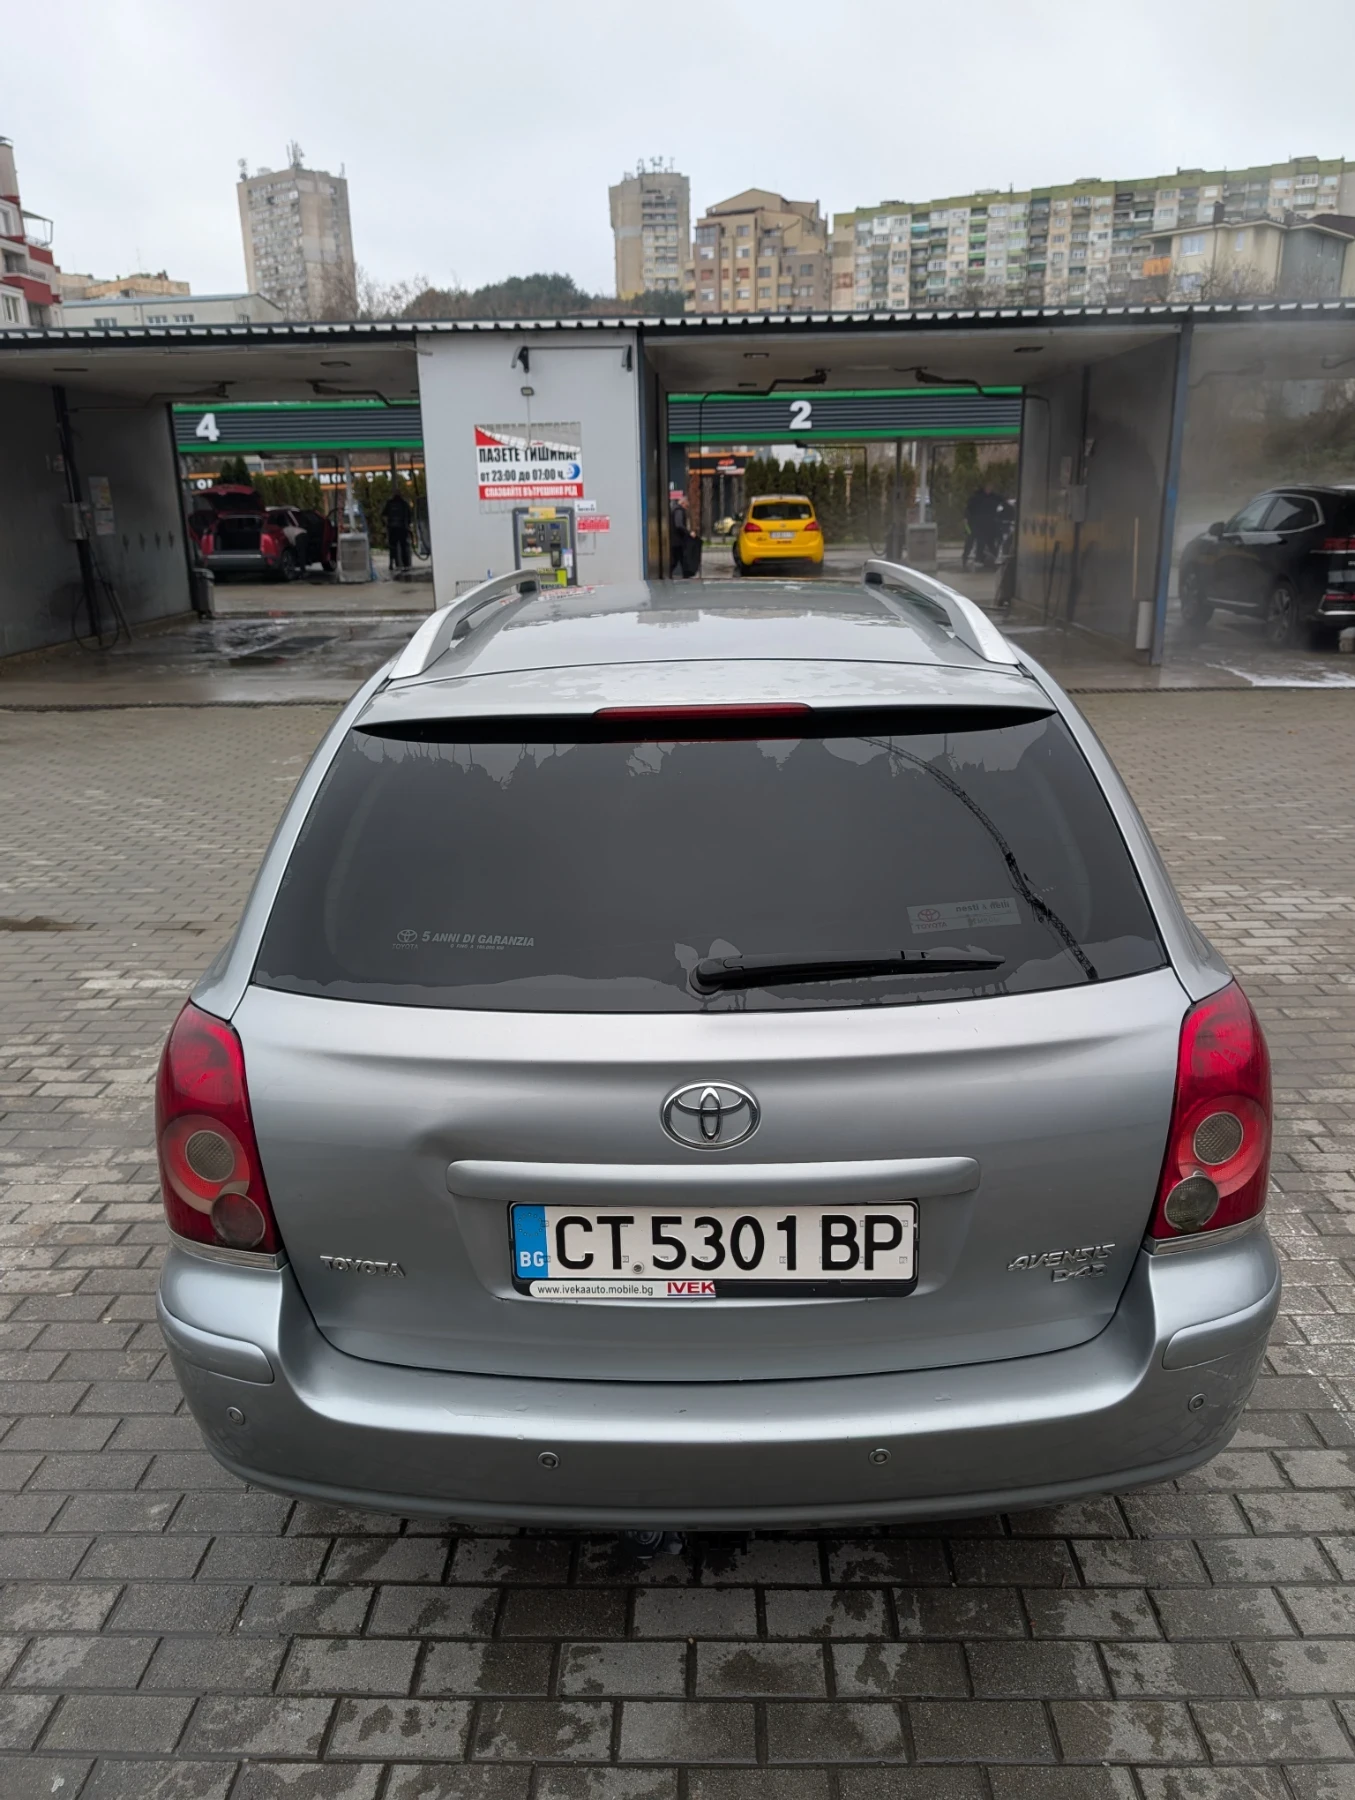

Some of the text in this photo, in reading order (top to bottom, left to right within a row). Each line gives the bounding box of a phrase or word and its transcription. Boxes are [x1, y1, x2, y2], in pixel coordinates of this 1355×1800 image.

[789, 400, 812, 430] 2
[195, 412, 220, 442] 4
[479, 447, 521, 463] ПАЗЕТЕ
[480, 472, 490, 482] от
[491, 469, 516, 482] 23:00
[518, 470, 531, 482] до
[532, 468, 556, 481] 07:00
[916, 921, 948, 930] TOYOTA
[421, 930, 535, 947] 5 ANNI DI GARANZIA
[555, 1214, 902, 1272] CT 5301 BP
[519, 1251, 545, 1268] BG
[1007, 1243, 1116, 1271] AVENSIS
[319, 1255, 405, 1279] TOYOTA
[537, 1284, 654, 1297] www.ivekaauto.mobile.bg
[667, 1281, 715, 1295] IVEK
